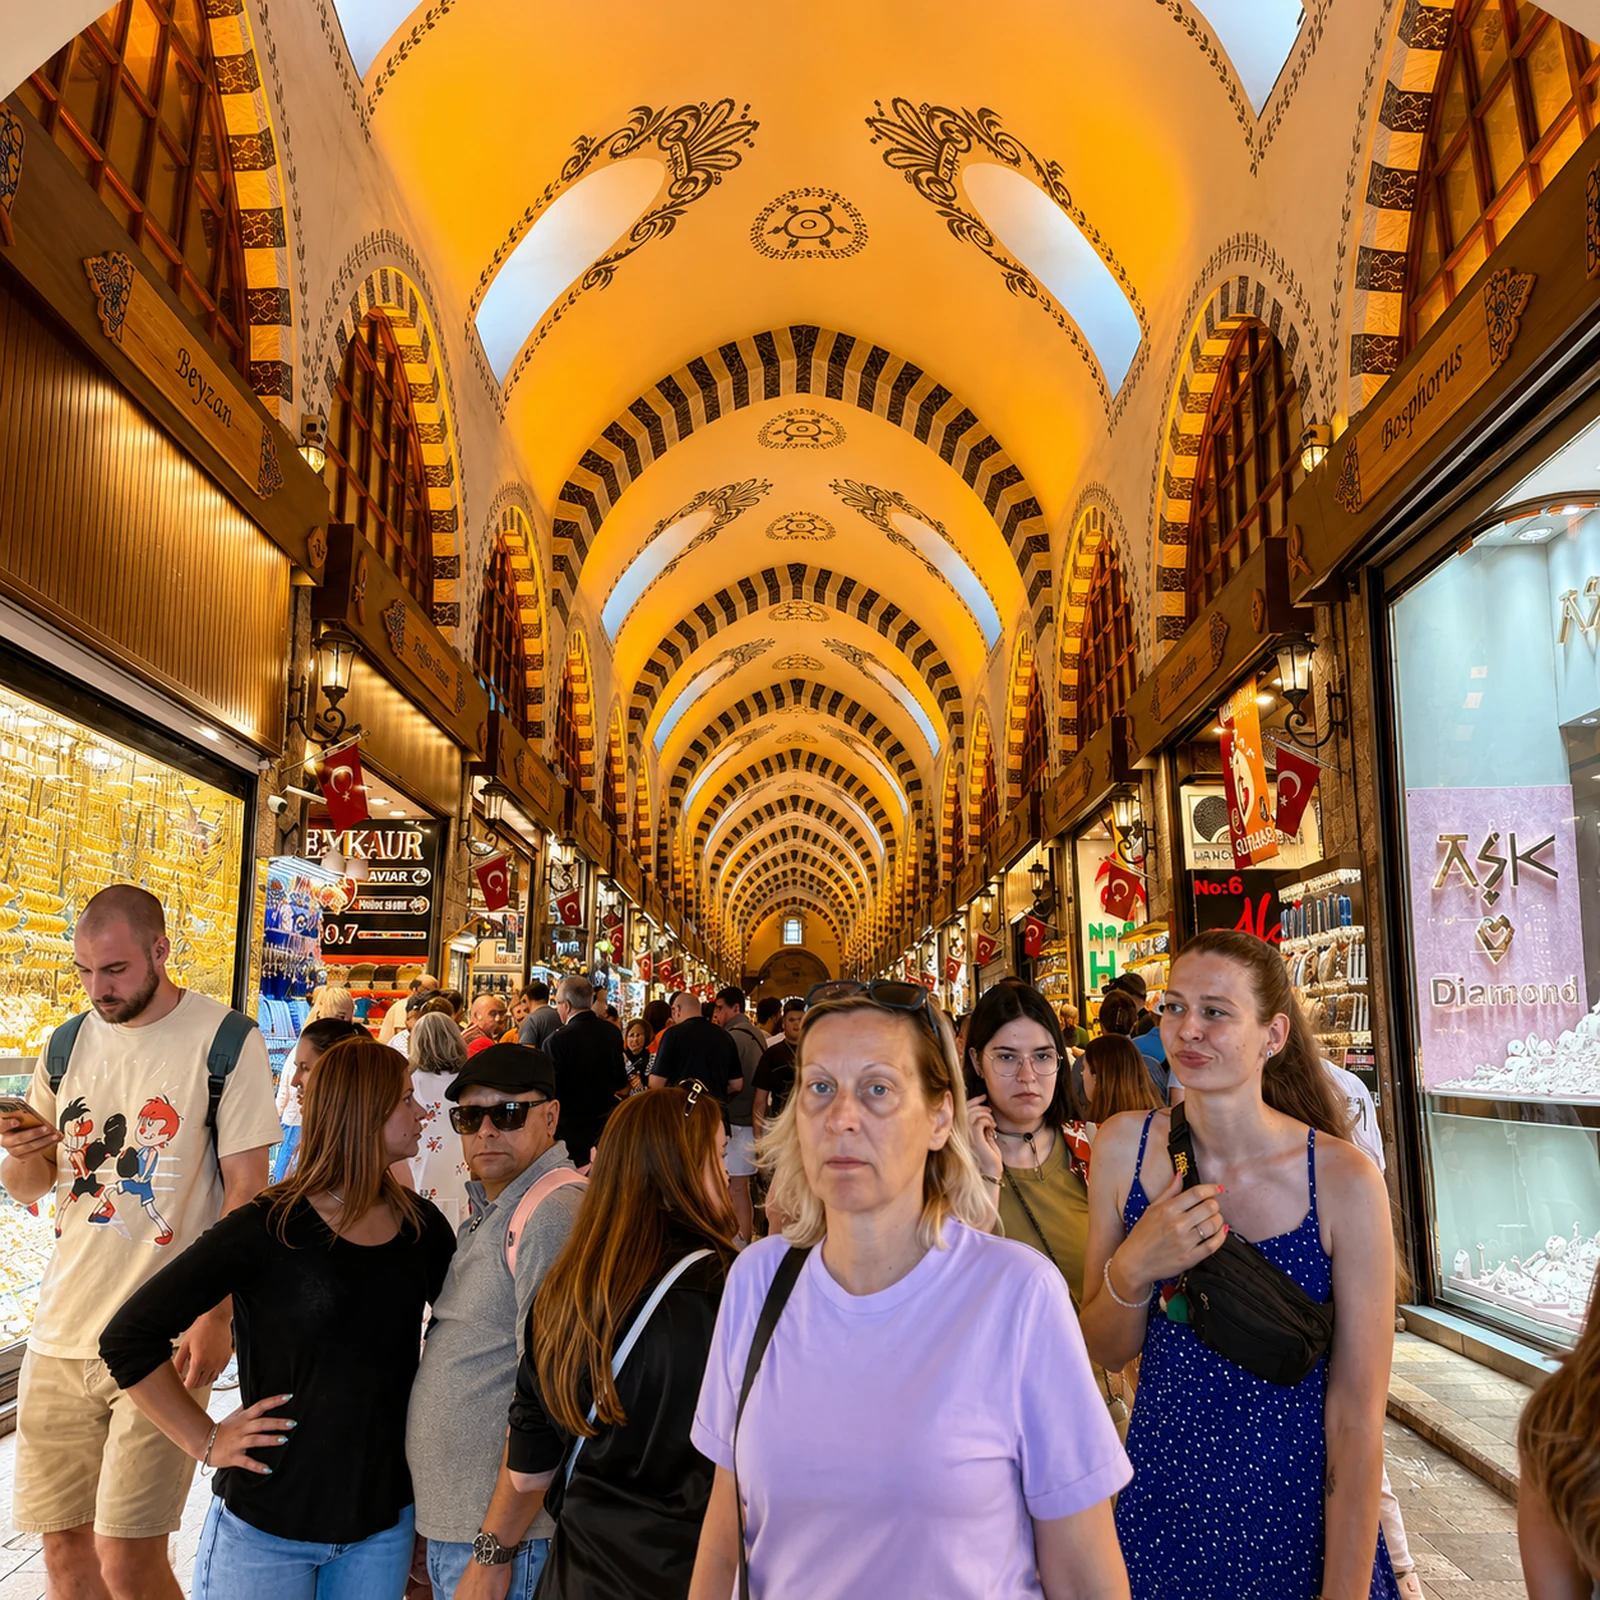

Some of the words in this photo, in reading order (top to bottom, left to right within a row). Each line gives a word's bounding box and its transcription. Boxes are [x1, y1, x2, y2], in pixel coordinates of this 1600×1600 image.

[174, 347, 232, 429] Beyzan
[1381, 343, 1463, 453] Bosphorus
[367, 870, 408, 882] AVIAR
[1194, 875, 1244, 896] No:6
[1430, 975, 1580, 1007] Diamond
